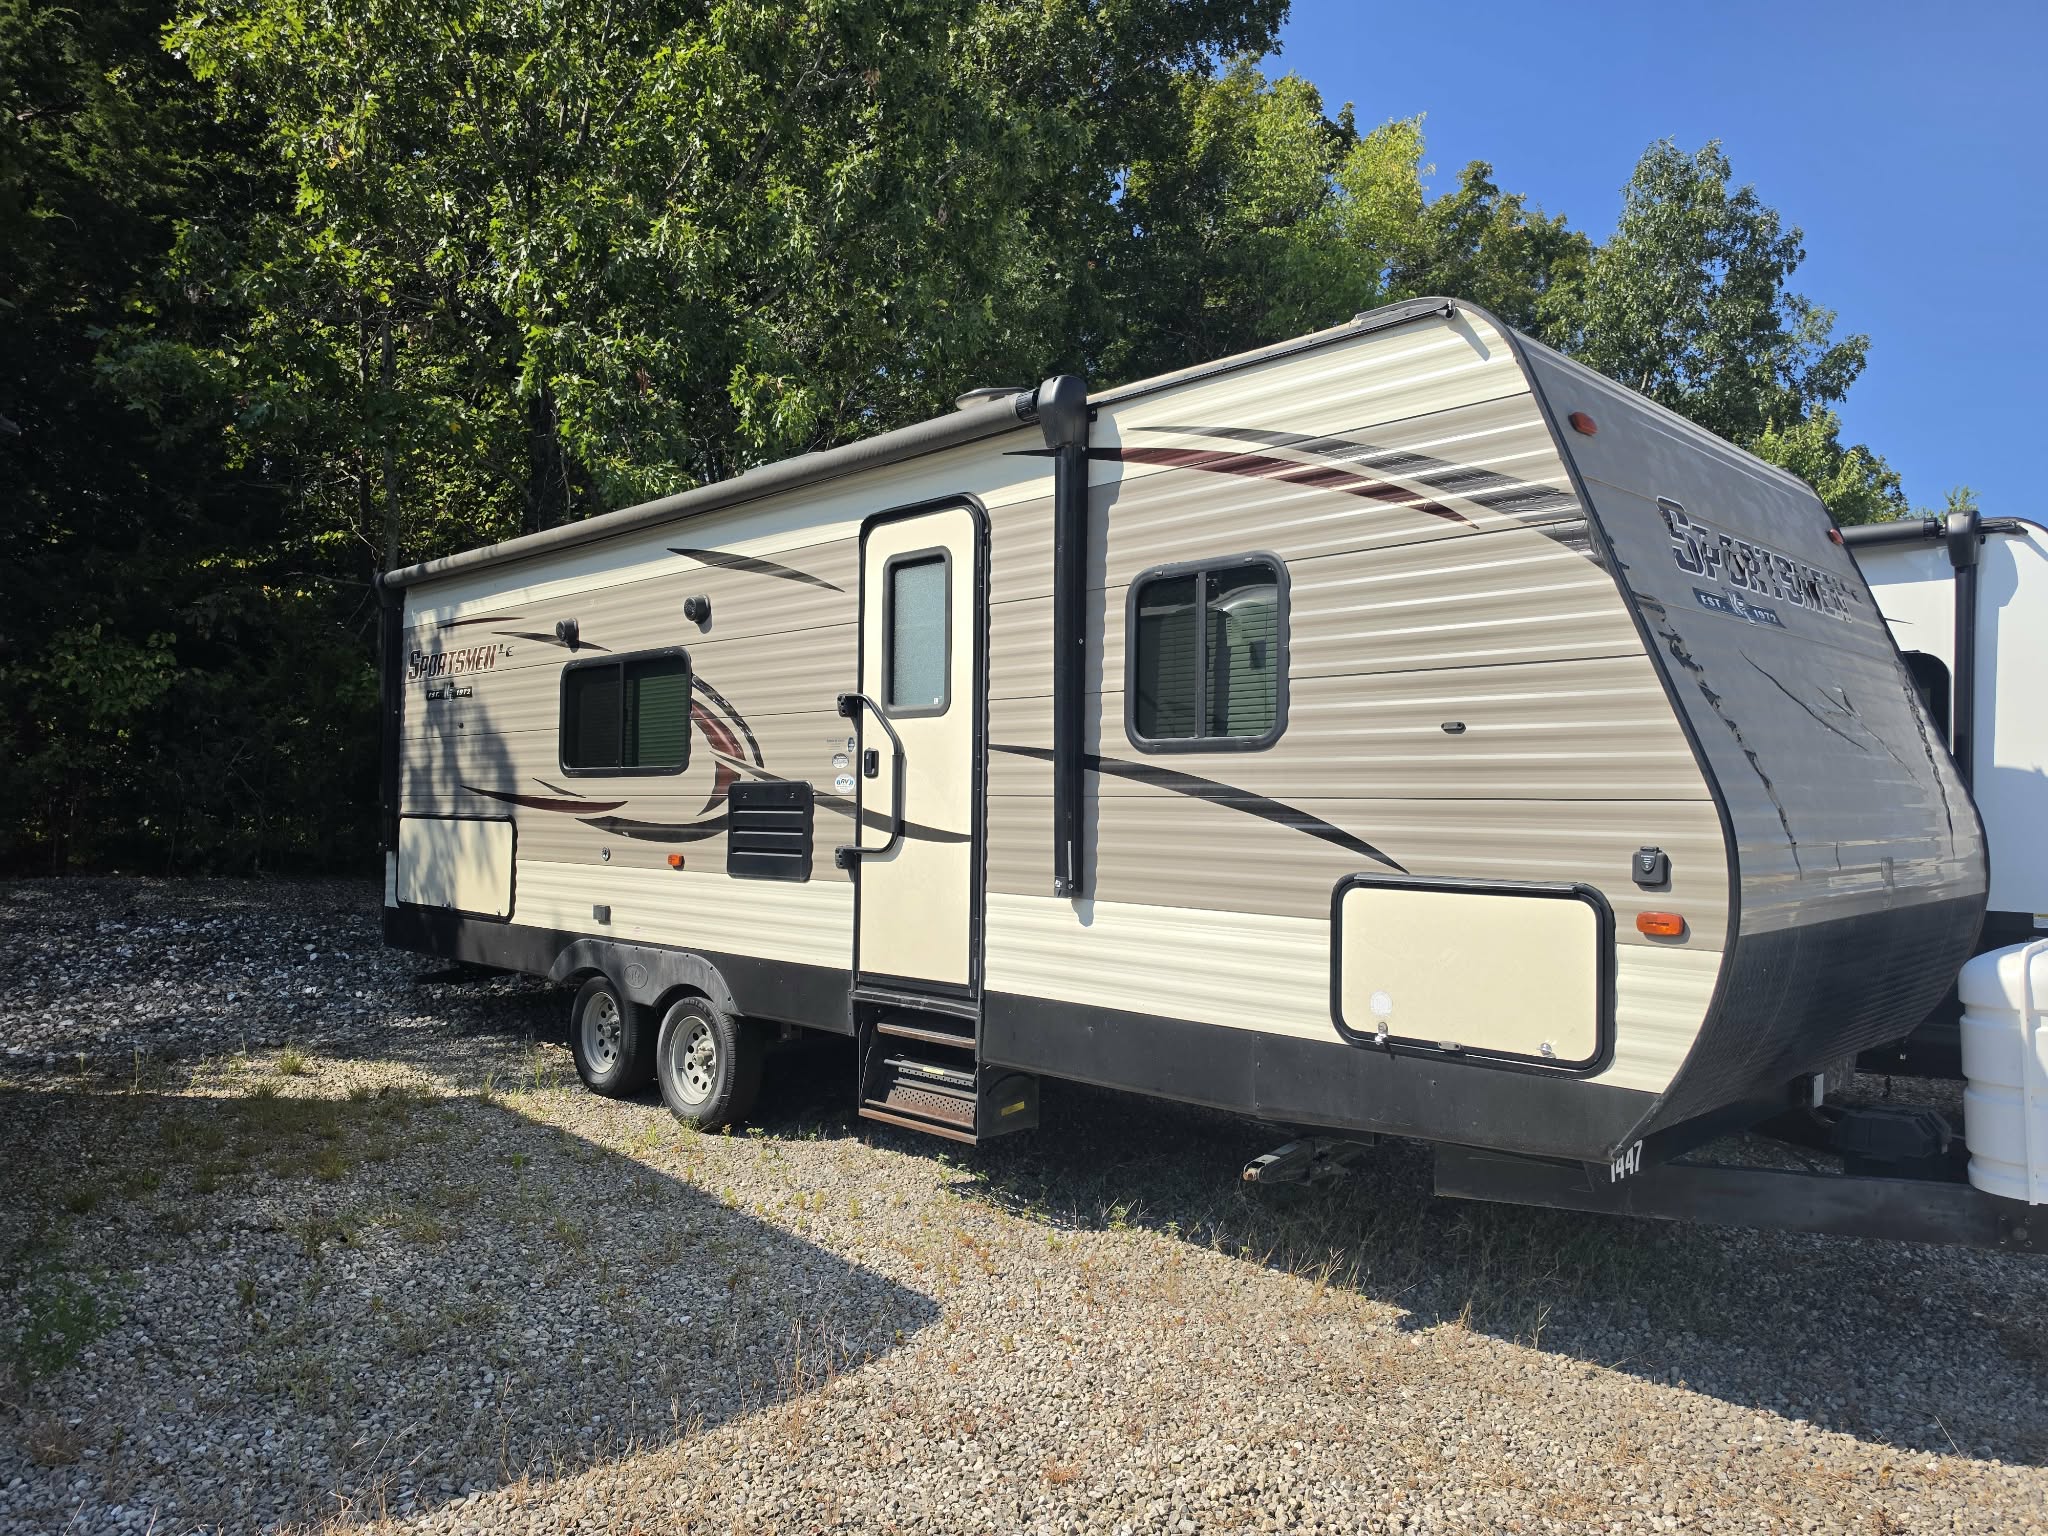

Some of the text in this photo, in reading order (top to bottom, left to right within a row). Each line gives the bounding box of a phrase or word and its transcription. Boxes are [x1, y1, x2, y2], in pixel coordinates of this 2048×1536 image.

[1699, 594, 1726, 609] EST.
[1753, 609, 1777, 623] 1972
[408, 644, 497, 681] SPORTSMEN
[1610, 1139, 1643, 1183] 1447
